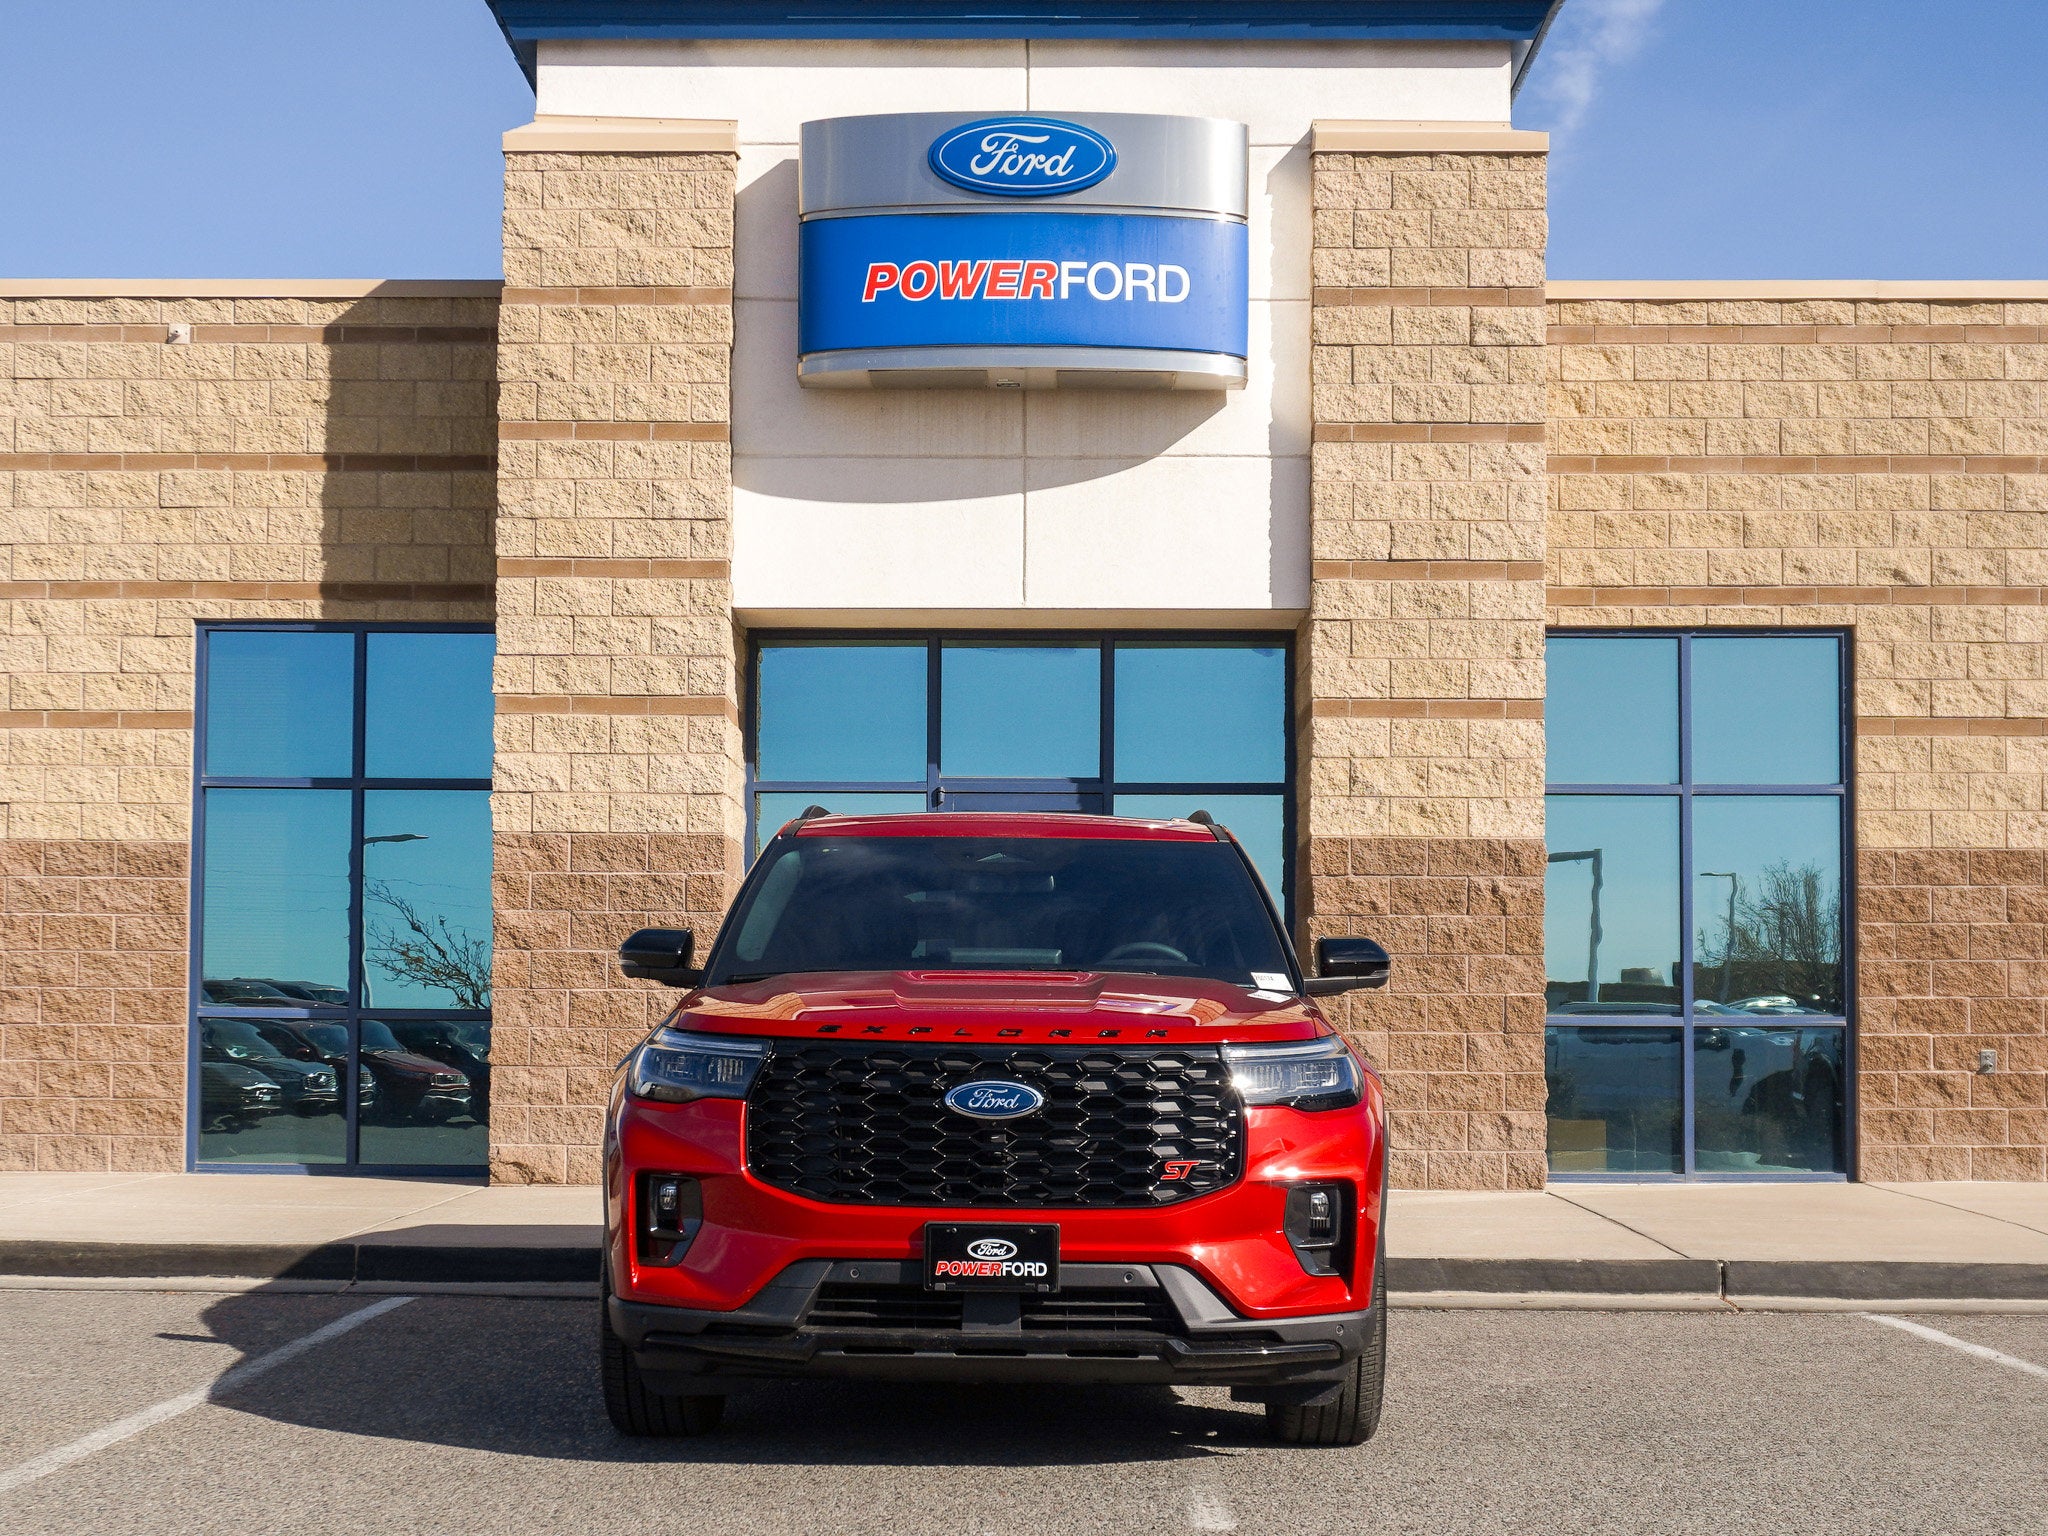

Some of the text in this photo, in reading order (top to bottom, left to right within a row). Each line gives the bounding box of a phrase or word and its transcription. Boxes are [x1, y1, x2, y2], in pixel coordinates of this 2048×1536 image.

[970, 132, 1075, 177] Ford
[818, 1024, 1169, 1038] EXPLORER
[968, 1088, 1021, 1109] Ford
[1160, 1160, 1200, 1180] ST
[977, 1242, 1008, 1256] Ford
